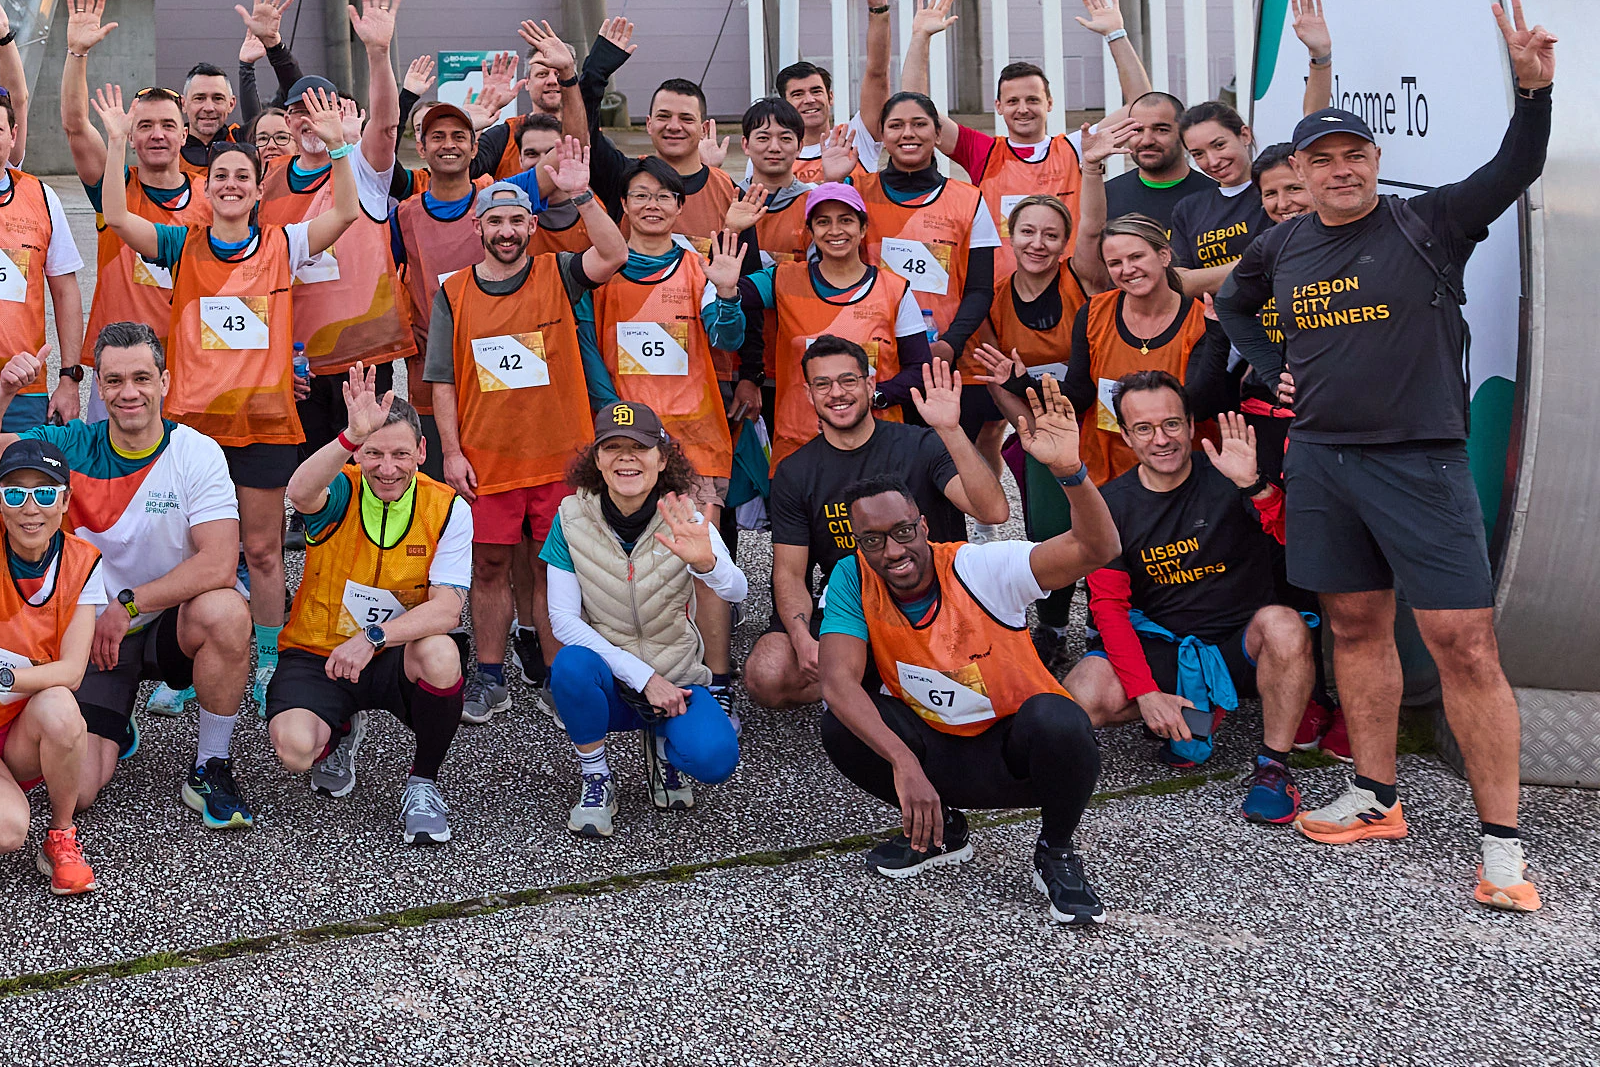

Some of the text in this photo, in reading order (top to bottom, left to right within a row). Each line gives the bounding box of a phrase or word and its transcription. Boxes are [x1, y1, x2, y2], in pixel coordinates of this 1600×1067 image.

[1303, 75, 1429, 138] lcome To
[1197, 221, 1248, 247] LISBON
[1197, 241, 1227, 261] CITY
[902, 258, 926, 274] 48
[1292, 276, 1359, 299] LISBON
[1292, 296, 1331, 314] CITY
[222, 315, 245, 331] 43
[1295, 304, 1390, 330] RUNNERS
[641, 341, 665, 357] 65
[499, 354, 523, 371] 42
[1140, 537, 1199, 563] LISBON
[1146, 558, 1181, 576] CITY
[354, 593, 379, 602] IPSEN
[366, 607, 394, 624] 57
[928, 689, 955, 708] 67
